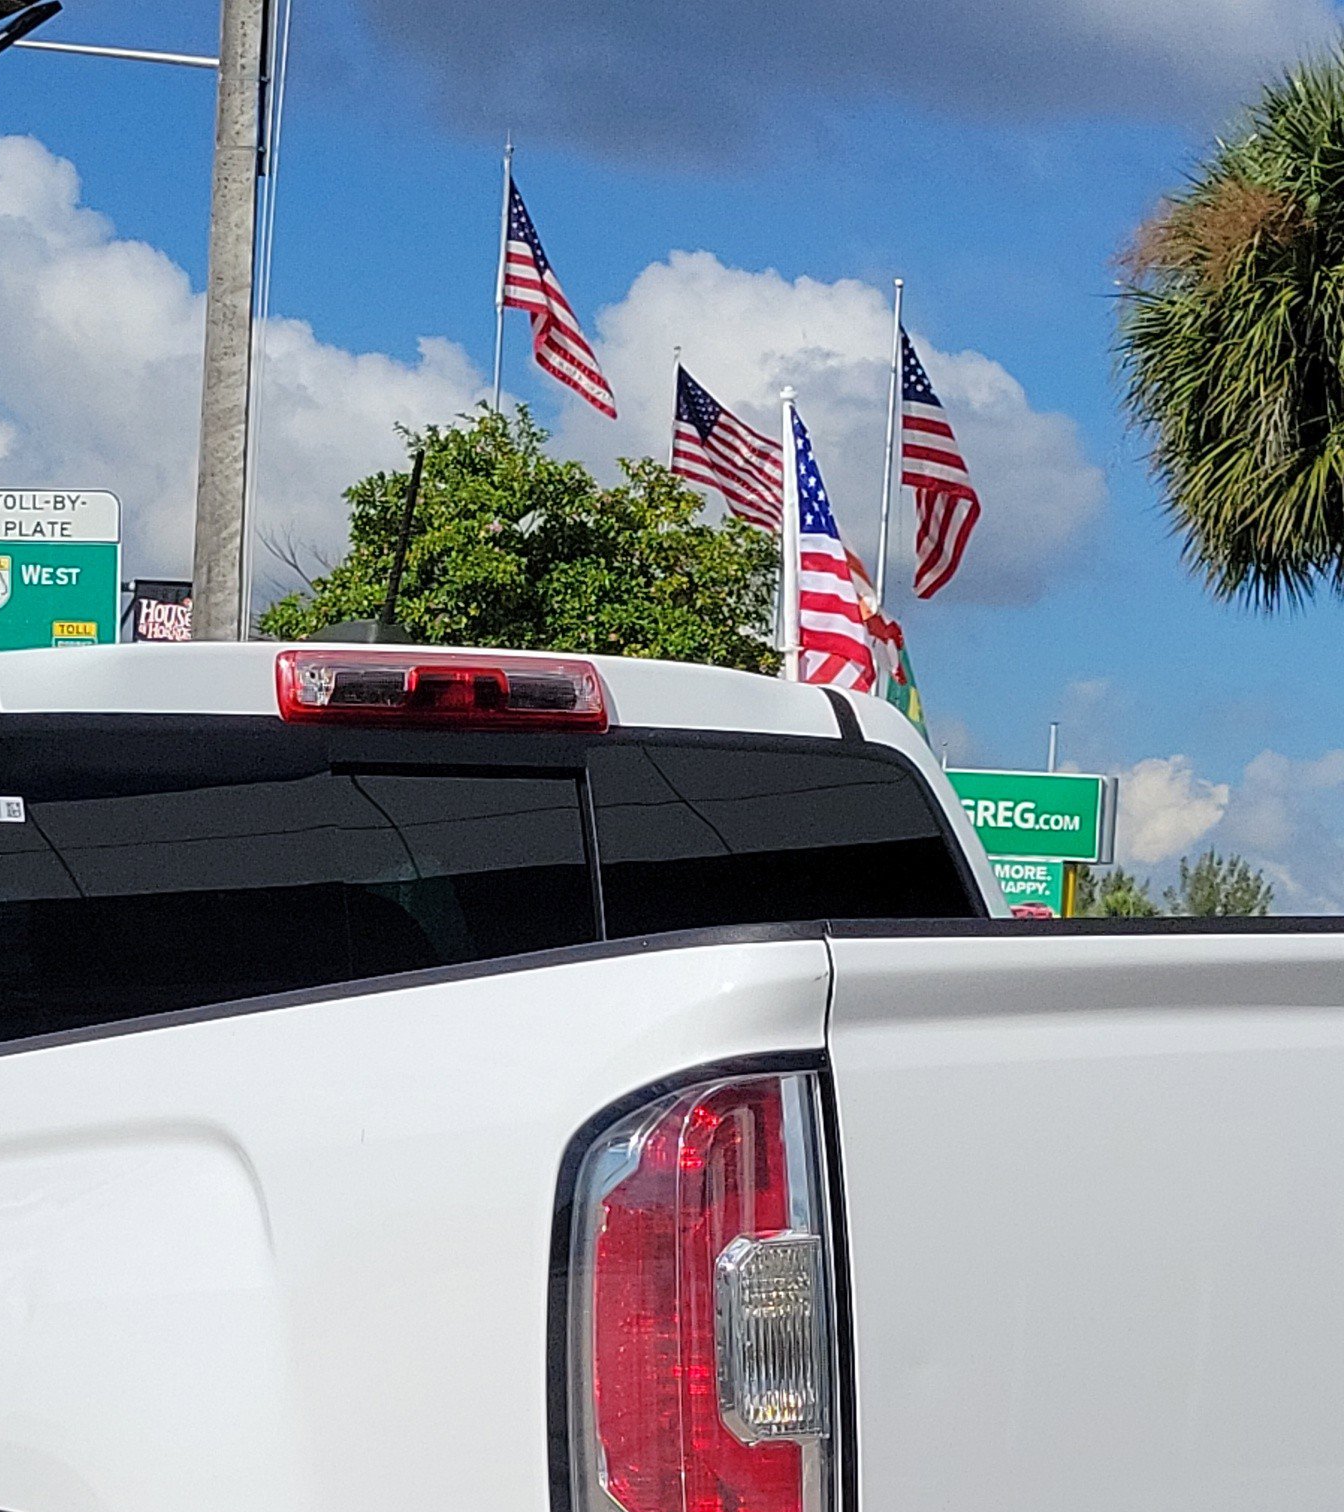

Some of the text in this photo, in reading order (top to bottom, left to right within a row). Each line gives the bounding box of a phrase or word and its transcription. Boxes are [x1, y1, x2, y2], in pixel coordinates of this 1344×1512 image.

[4, 521, 72, 537] PLATE
[21, 564, 81, 585] WEST
[59, 624, 91, 635] TOLL
[994, 864, 1052, 881] MORE.
